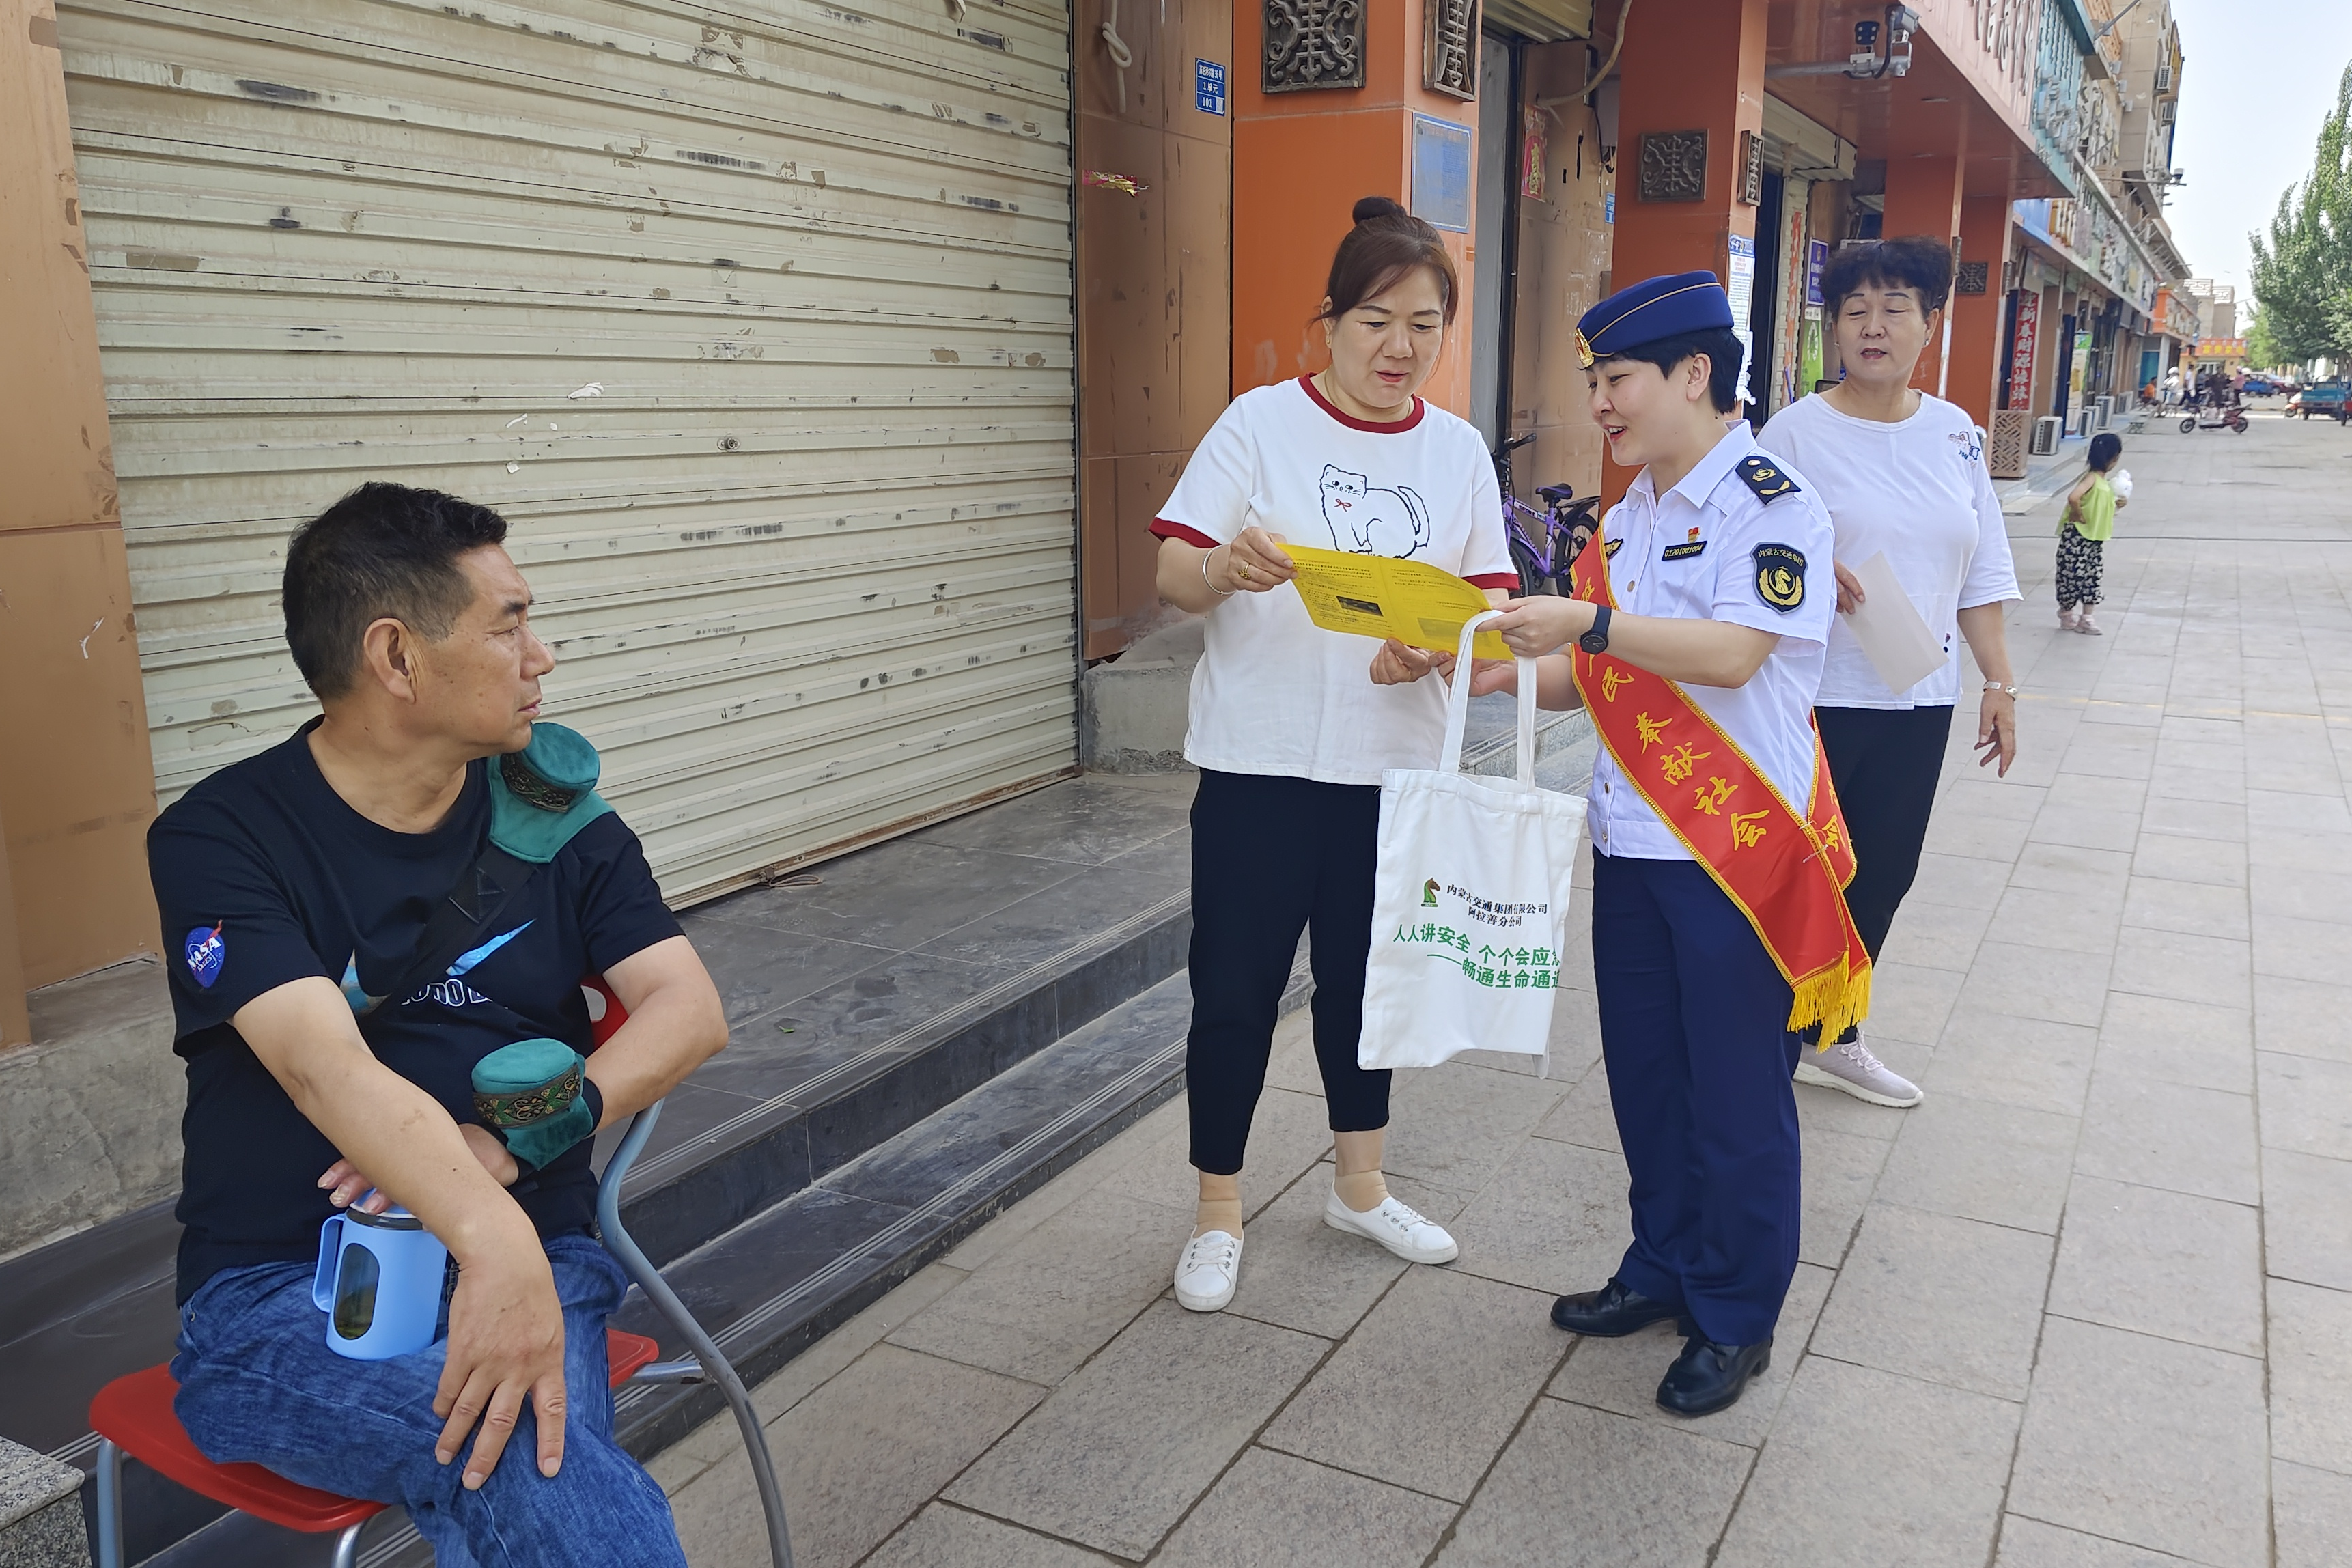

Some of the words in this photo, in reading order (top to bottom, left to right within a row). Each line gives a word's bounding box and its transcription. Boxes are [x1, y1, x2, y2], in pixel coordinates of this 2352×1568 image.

[1203, 82, 1218, 94] 1单元
[1203, 97, 1212, 108] 101
[1758, 548, 1804, 567] 内蒙古交通集团
[1580, 576, 1770, 852] 民奉献社会
[1446, 884, 1548, 915] 内蒙古交通集团有限公司
[1468, 906, 1522, 927] 阿拉善分公司
[1392, 923, 1471, 954] 人人讲安全
[187, 936, 222, 971] NASA
